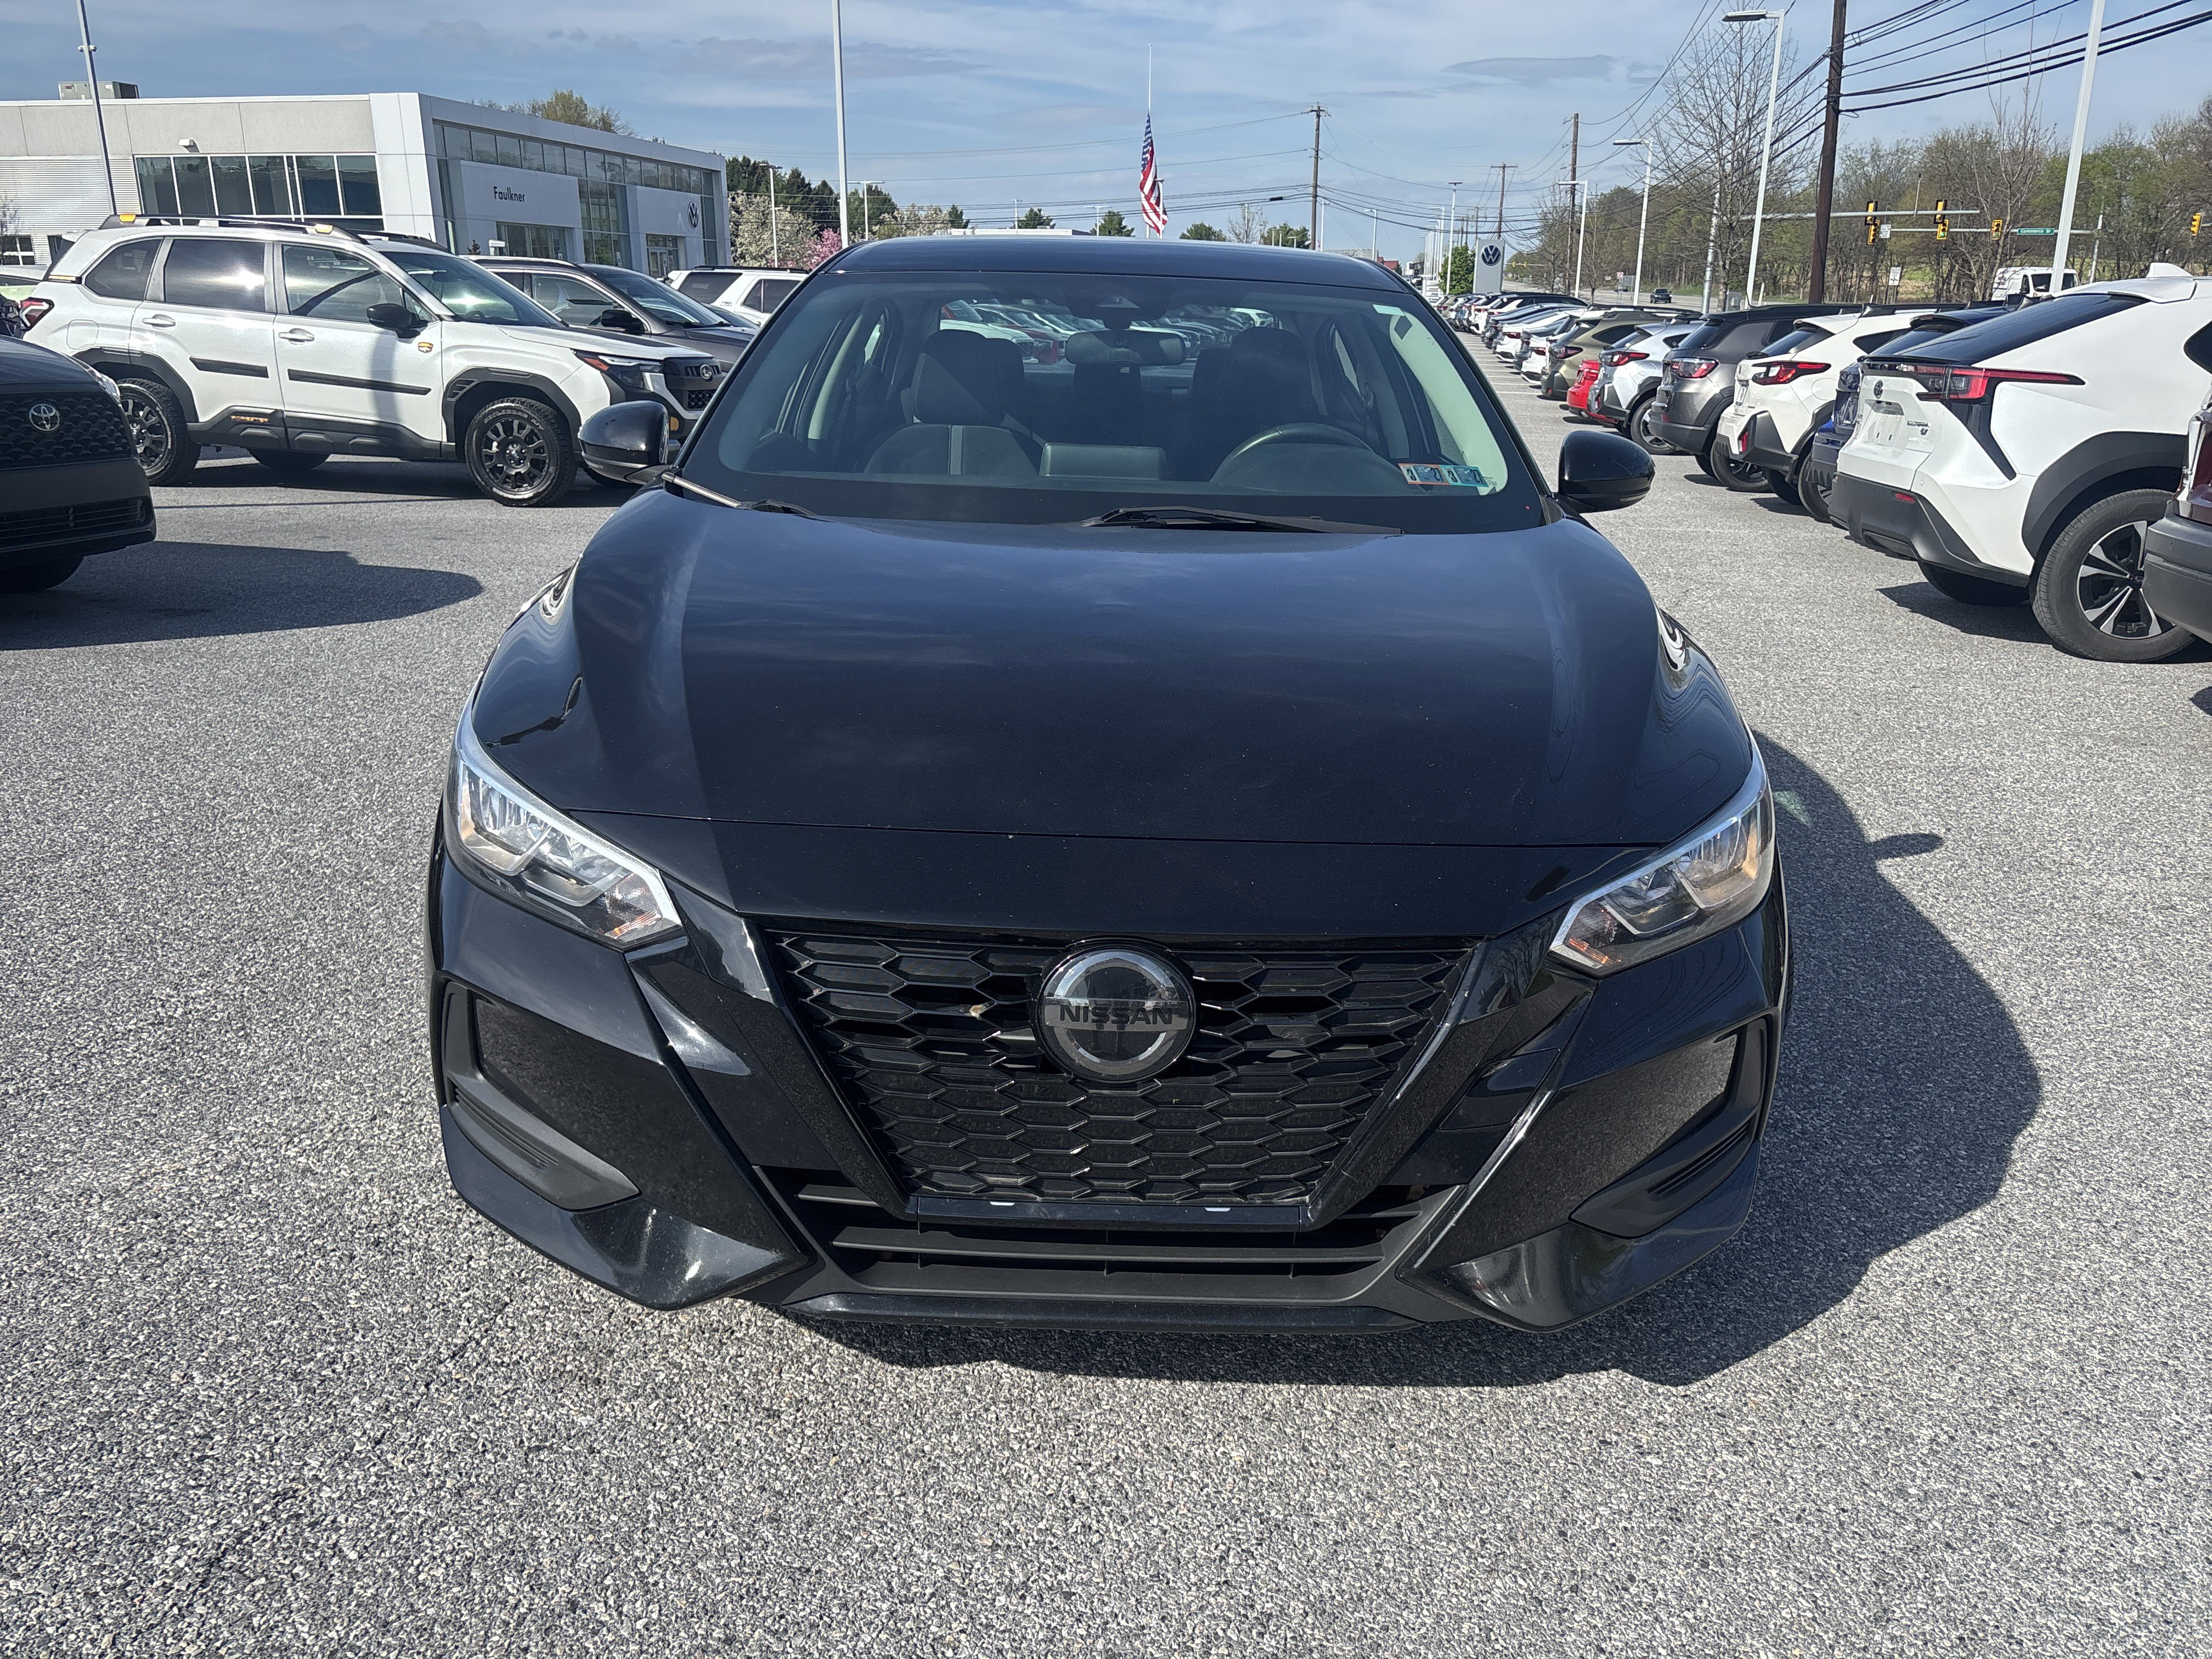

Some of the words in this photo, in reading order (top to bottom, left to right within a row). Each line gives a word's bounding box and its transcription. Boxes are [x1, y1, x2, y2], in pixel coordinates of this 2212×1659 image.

[493, 185, 525, 202] Faulkner
[1481, 245, 1501, 266] VW
[1059, 1004, 1173, 1025] NISSAN
